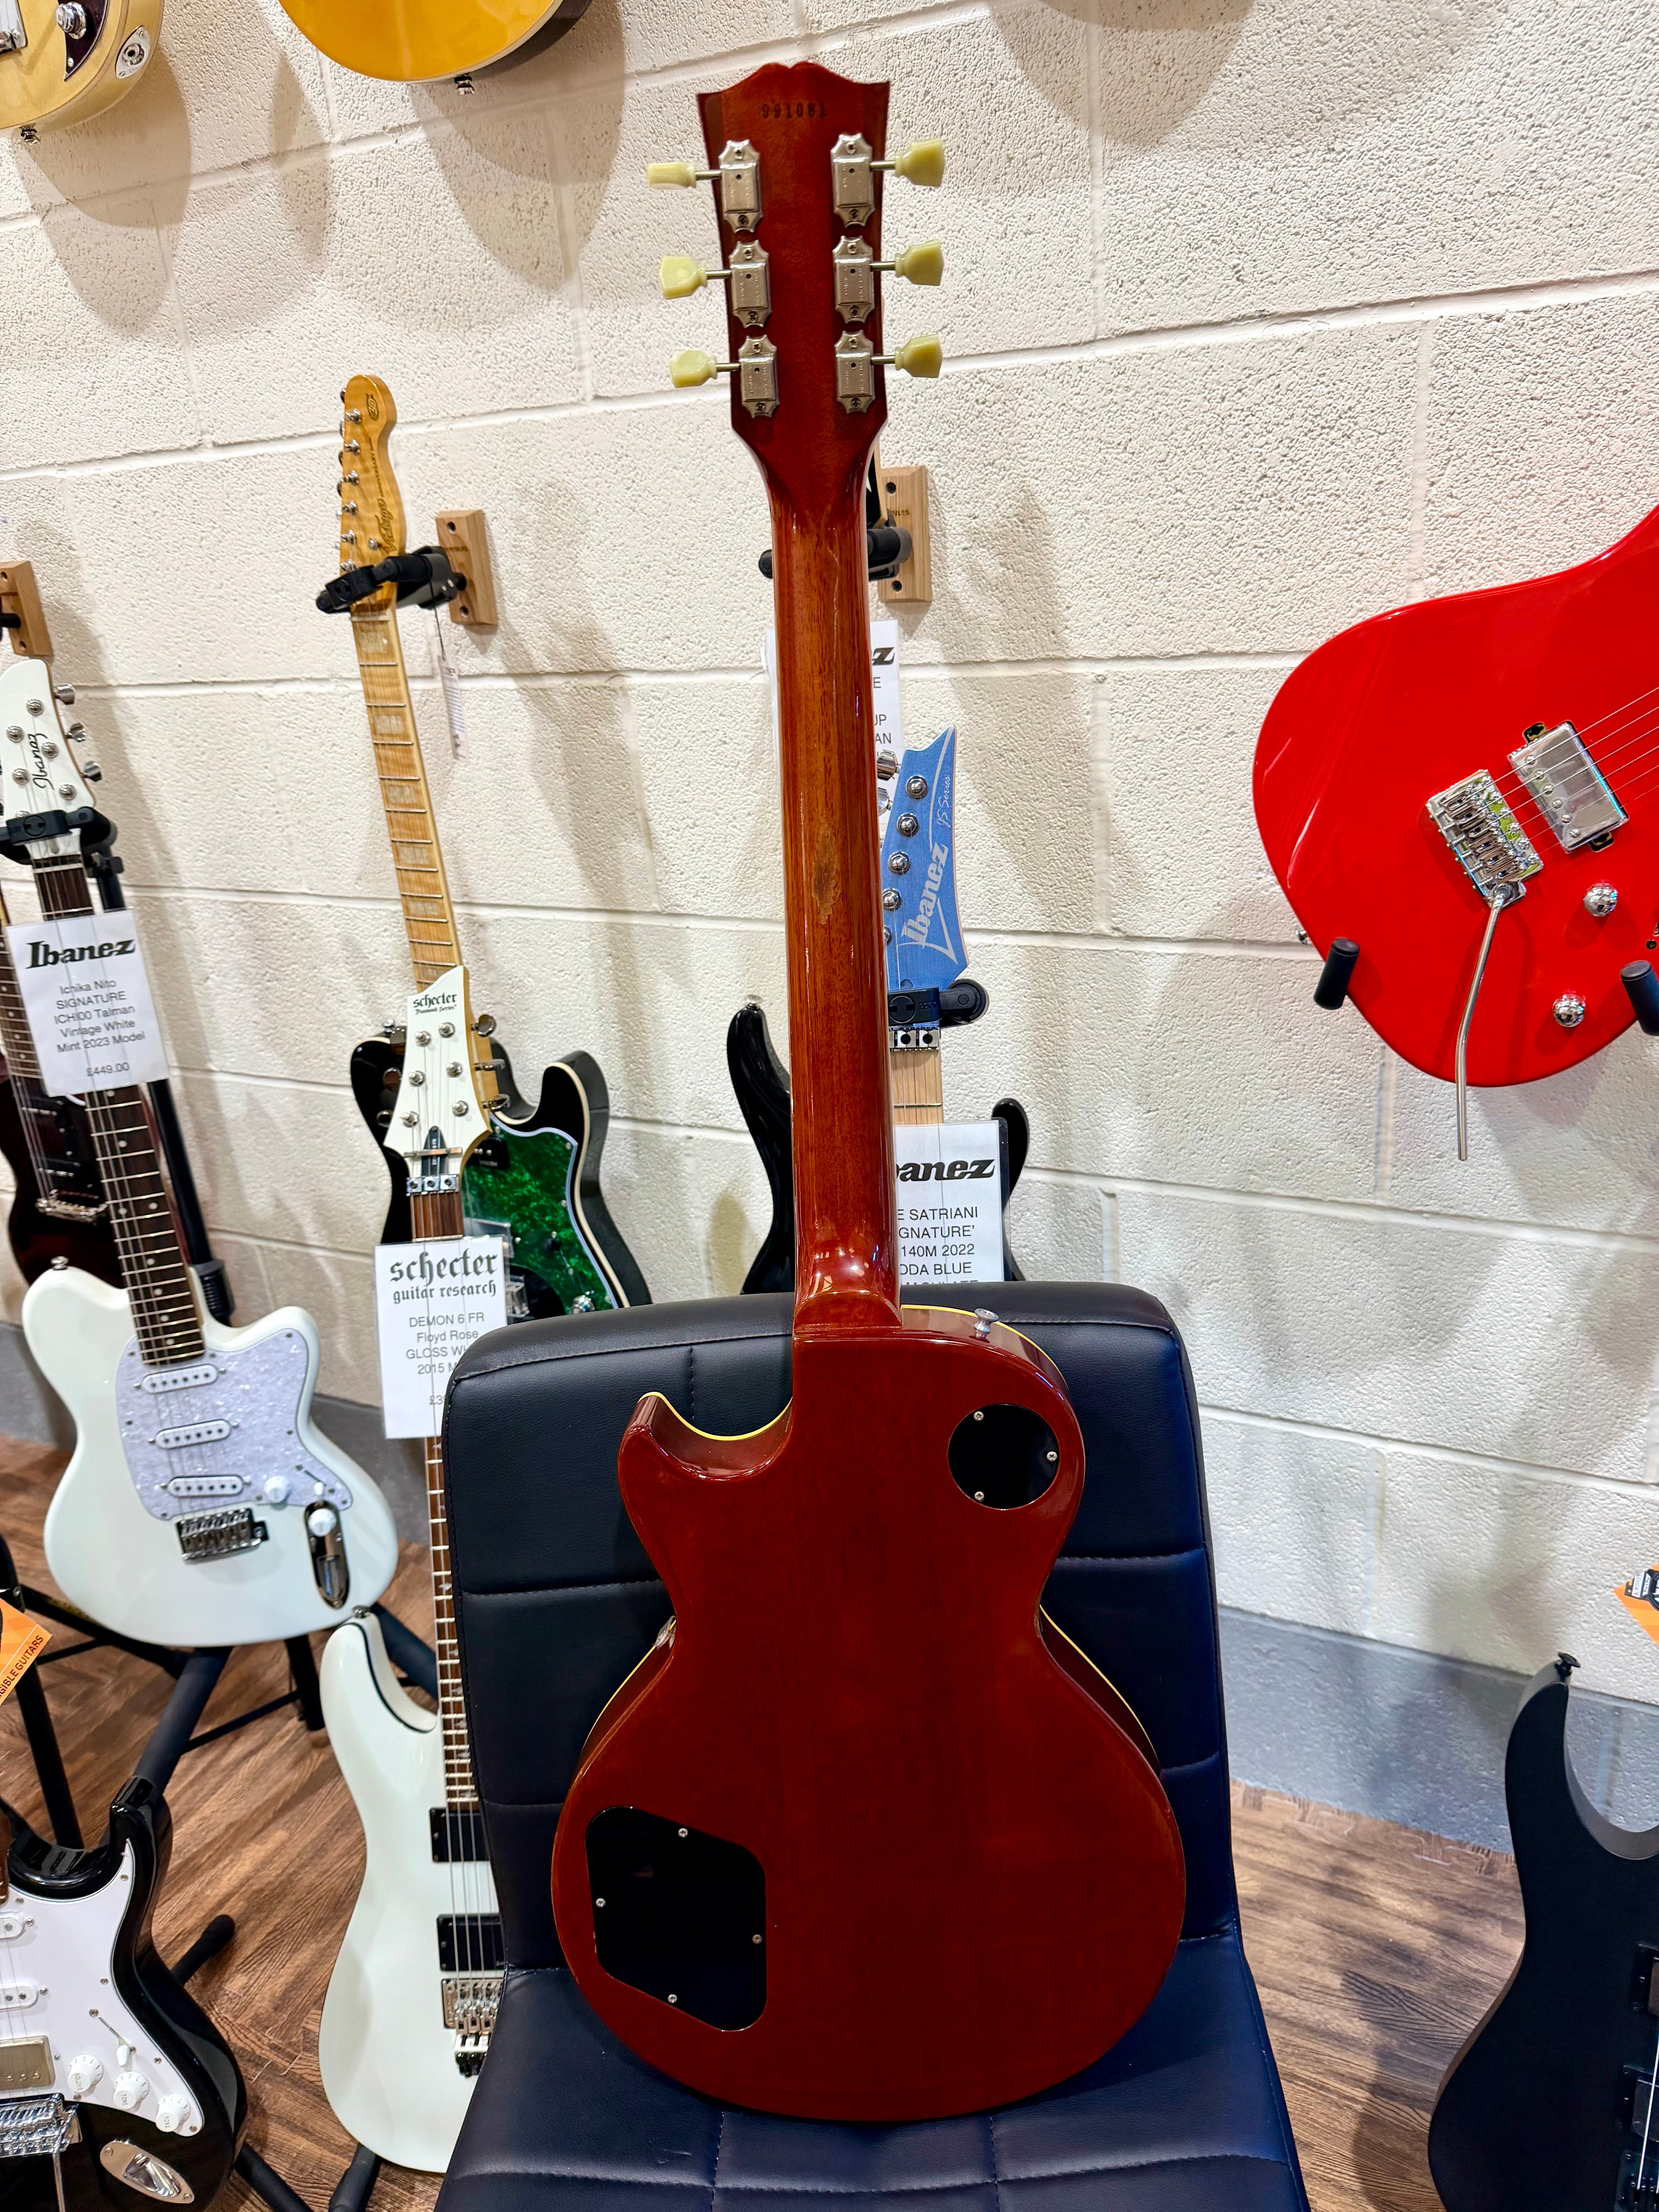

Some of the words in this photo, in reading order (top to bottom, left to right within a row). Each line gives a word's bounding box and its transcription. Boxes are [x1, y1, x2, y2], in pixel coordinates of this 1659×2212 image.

[27, 733, 54, 790] Ibanez
[938, 776, 951, 808] Series
[901, 842, 948, 948] Ibanez
[26, 939, 136, 969] Ibanez
[60, 983, 92, 994] Ichika
[94, 980, 116, 990] Nito
[56, 991, 127, 1010] SIGNATURE
[413, 993, 457, 1008] schecter
[94, 1006, 135, 1018] Talman
[60, 1025, 101, 1037] Vintage
[103, 1020, 135, 1031] White
[57, 1042, 81, 1053] Mint
[83, 1037, 110, 1049] 2023
[112, 1031, 146, 1044] Model
[86, 1062, 130, 1076] £449.00
[896, 1159, 995, 1182] anez
[910, 1206, 978, 1221] SATRIANI
[942, 1243, 975, 1256] 2022
[389, 1248, 498, 1286] schecter
[934, 1262, 972, 1275] BLUE
[393, 1285, 434, 1304] guitar
[440, 1279, 496, 1298] research
[409, 1314, 454, 1328] DEMON
[458, 1313, 465, 1324] 6
[468, 1312, 485, 1322] FR
[417, 1331, 447, 1344] Floyd
[450, 1329, 479, 1340] Rose
[406, 1347, 448, 1359] GLOSS
[417, 1364, 445, 1374] 2015
[0, 1669, 19, 1699] GIBLE
[15, 1635, 43, 1670] GUITARS
